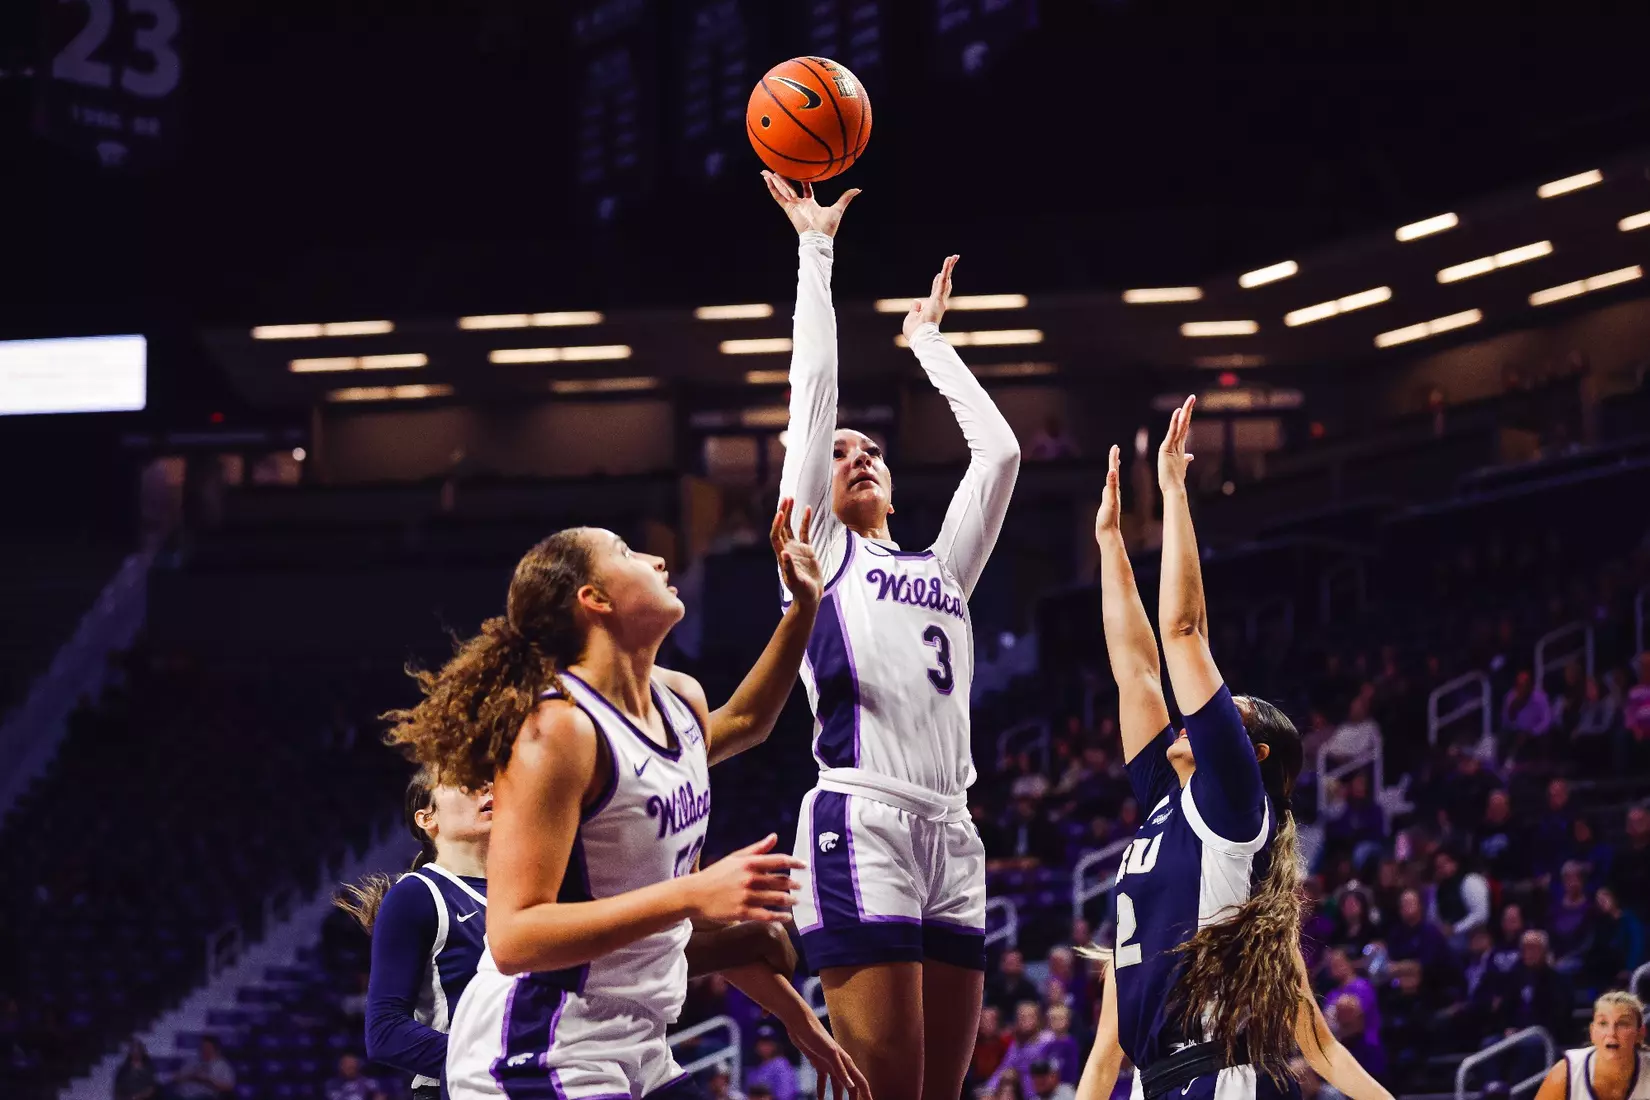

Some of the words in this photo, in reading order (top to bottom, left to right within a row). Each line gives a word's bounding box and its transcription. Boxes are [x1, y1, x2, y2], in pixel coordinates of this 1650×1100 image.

[52, 0, 182, 98] 23
[866, 568, 965, 622] Wildca
[922, 622, 955, 696] 3
[647, 781, 709, 839] Wildca
